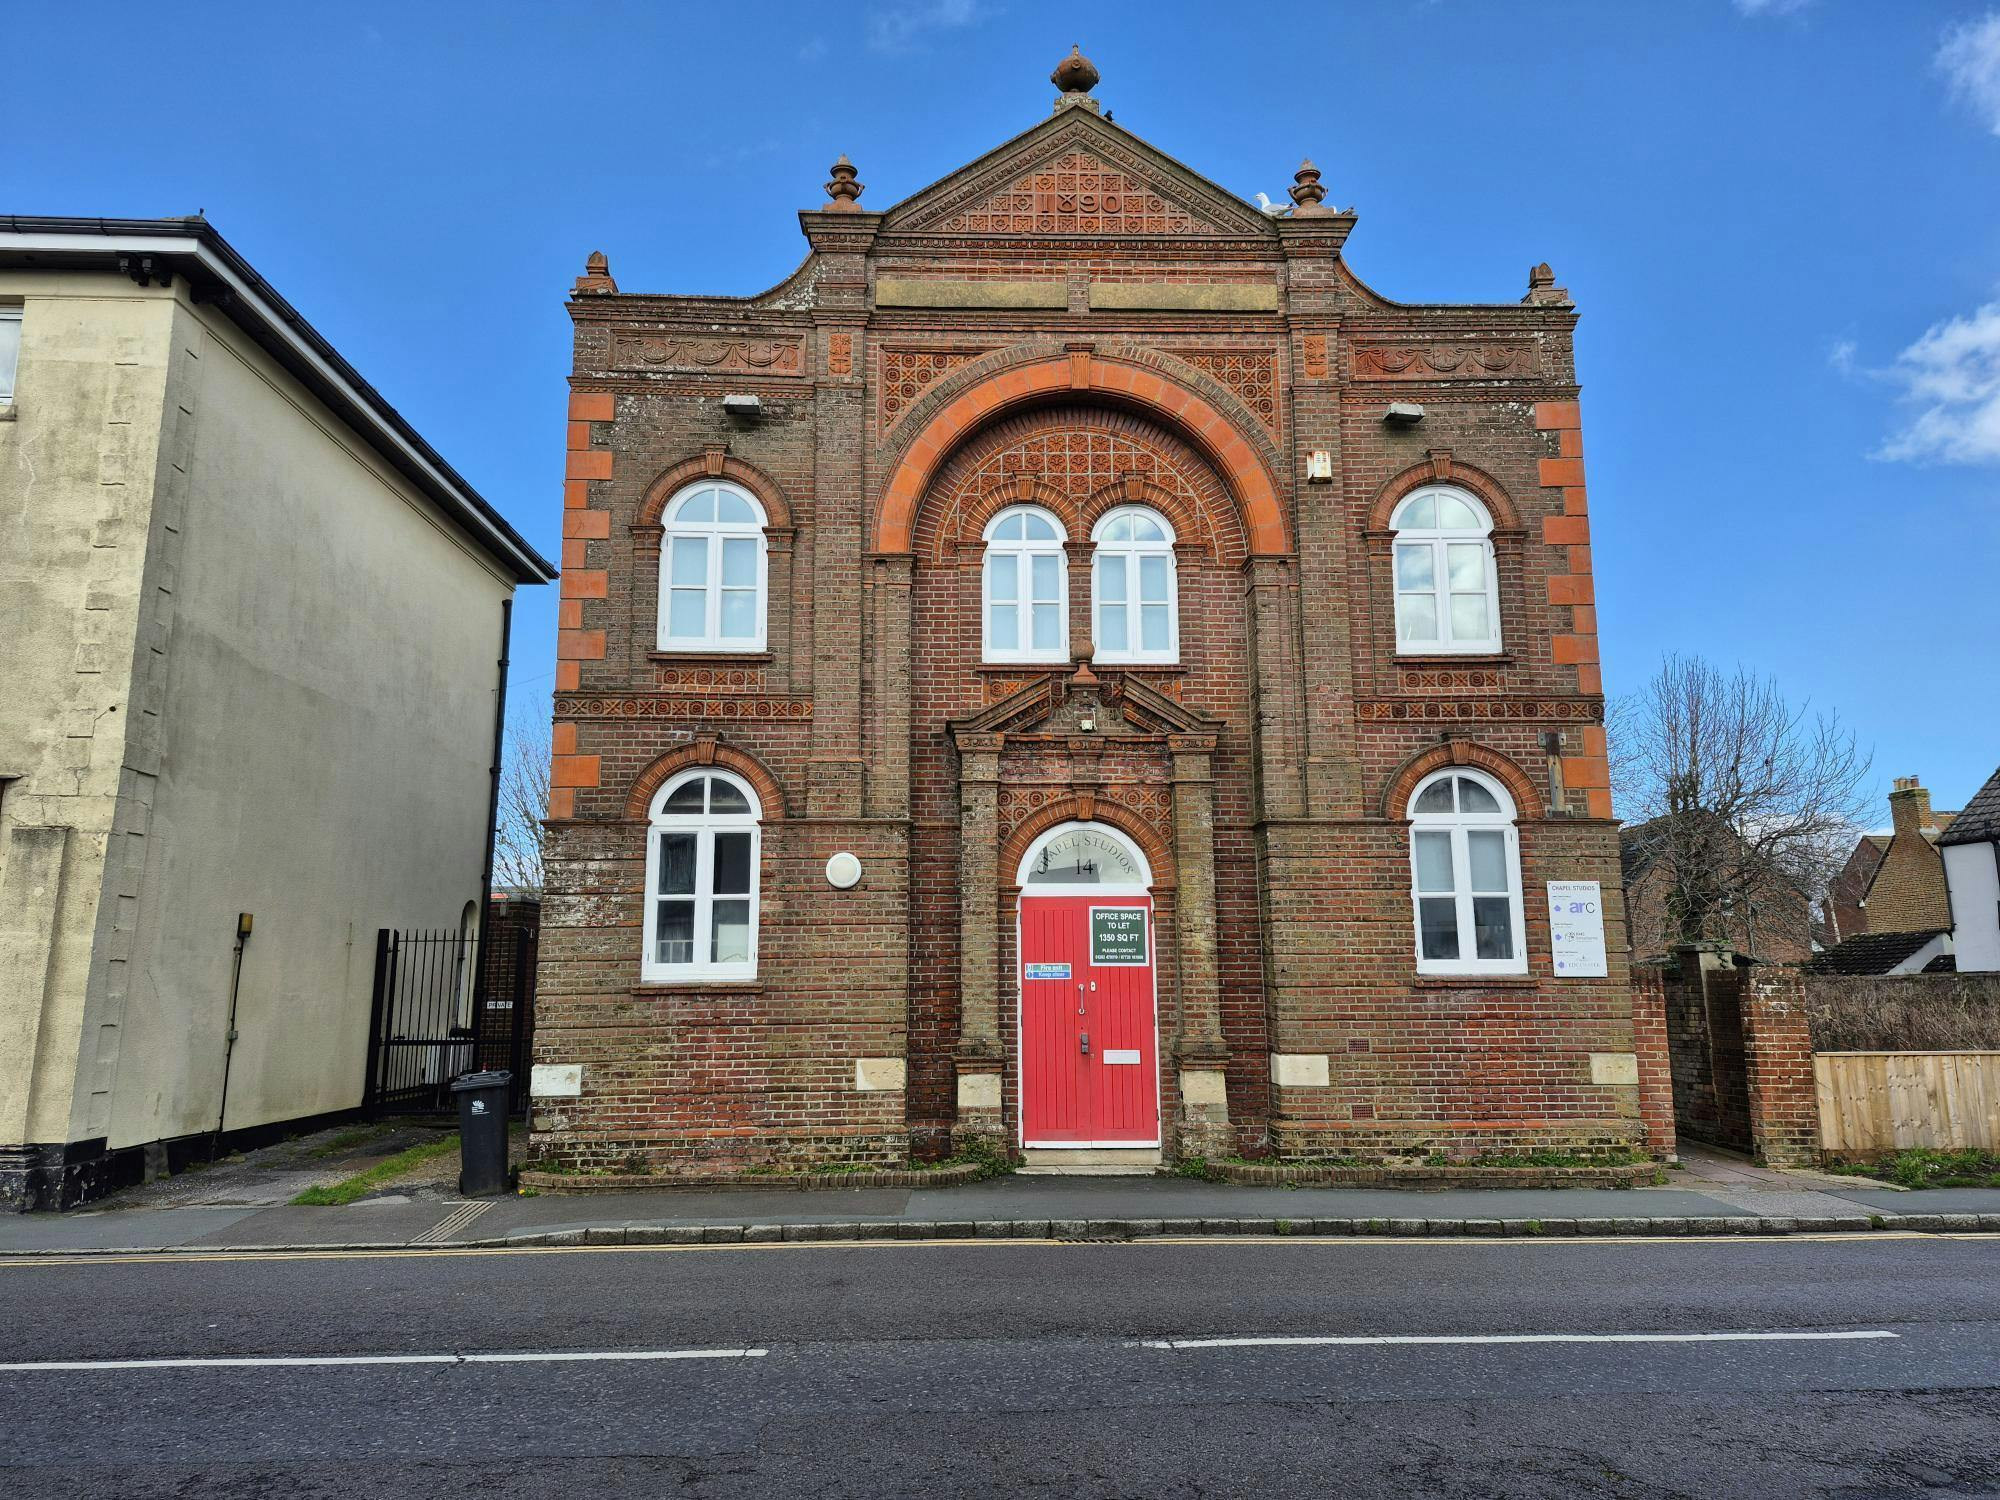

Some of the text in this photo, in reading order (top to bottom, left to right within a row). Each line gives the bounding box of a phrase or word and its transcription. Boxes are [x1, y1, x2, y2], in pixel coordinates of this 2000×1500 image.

[1040, 193, 1122, 214] 1890
[1037, 836, 1134, 875] CHAPEL STUDIOS
[1076, 858, 1094, 875] 14
[1095, 912, 1142, 921] OFFICE SPACE
[1099, 933, 1140, 942] 1350 SQ FT
